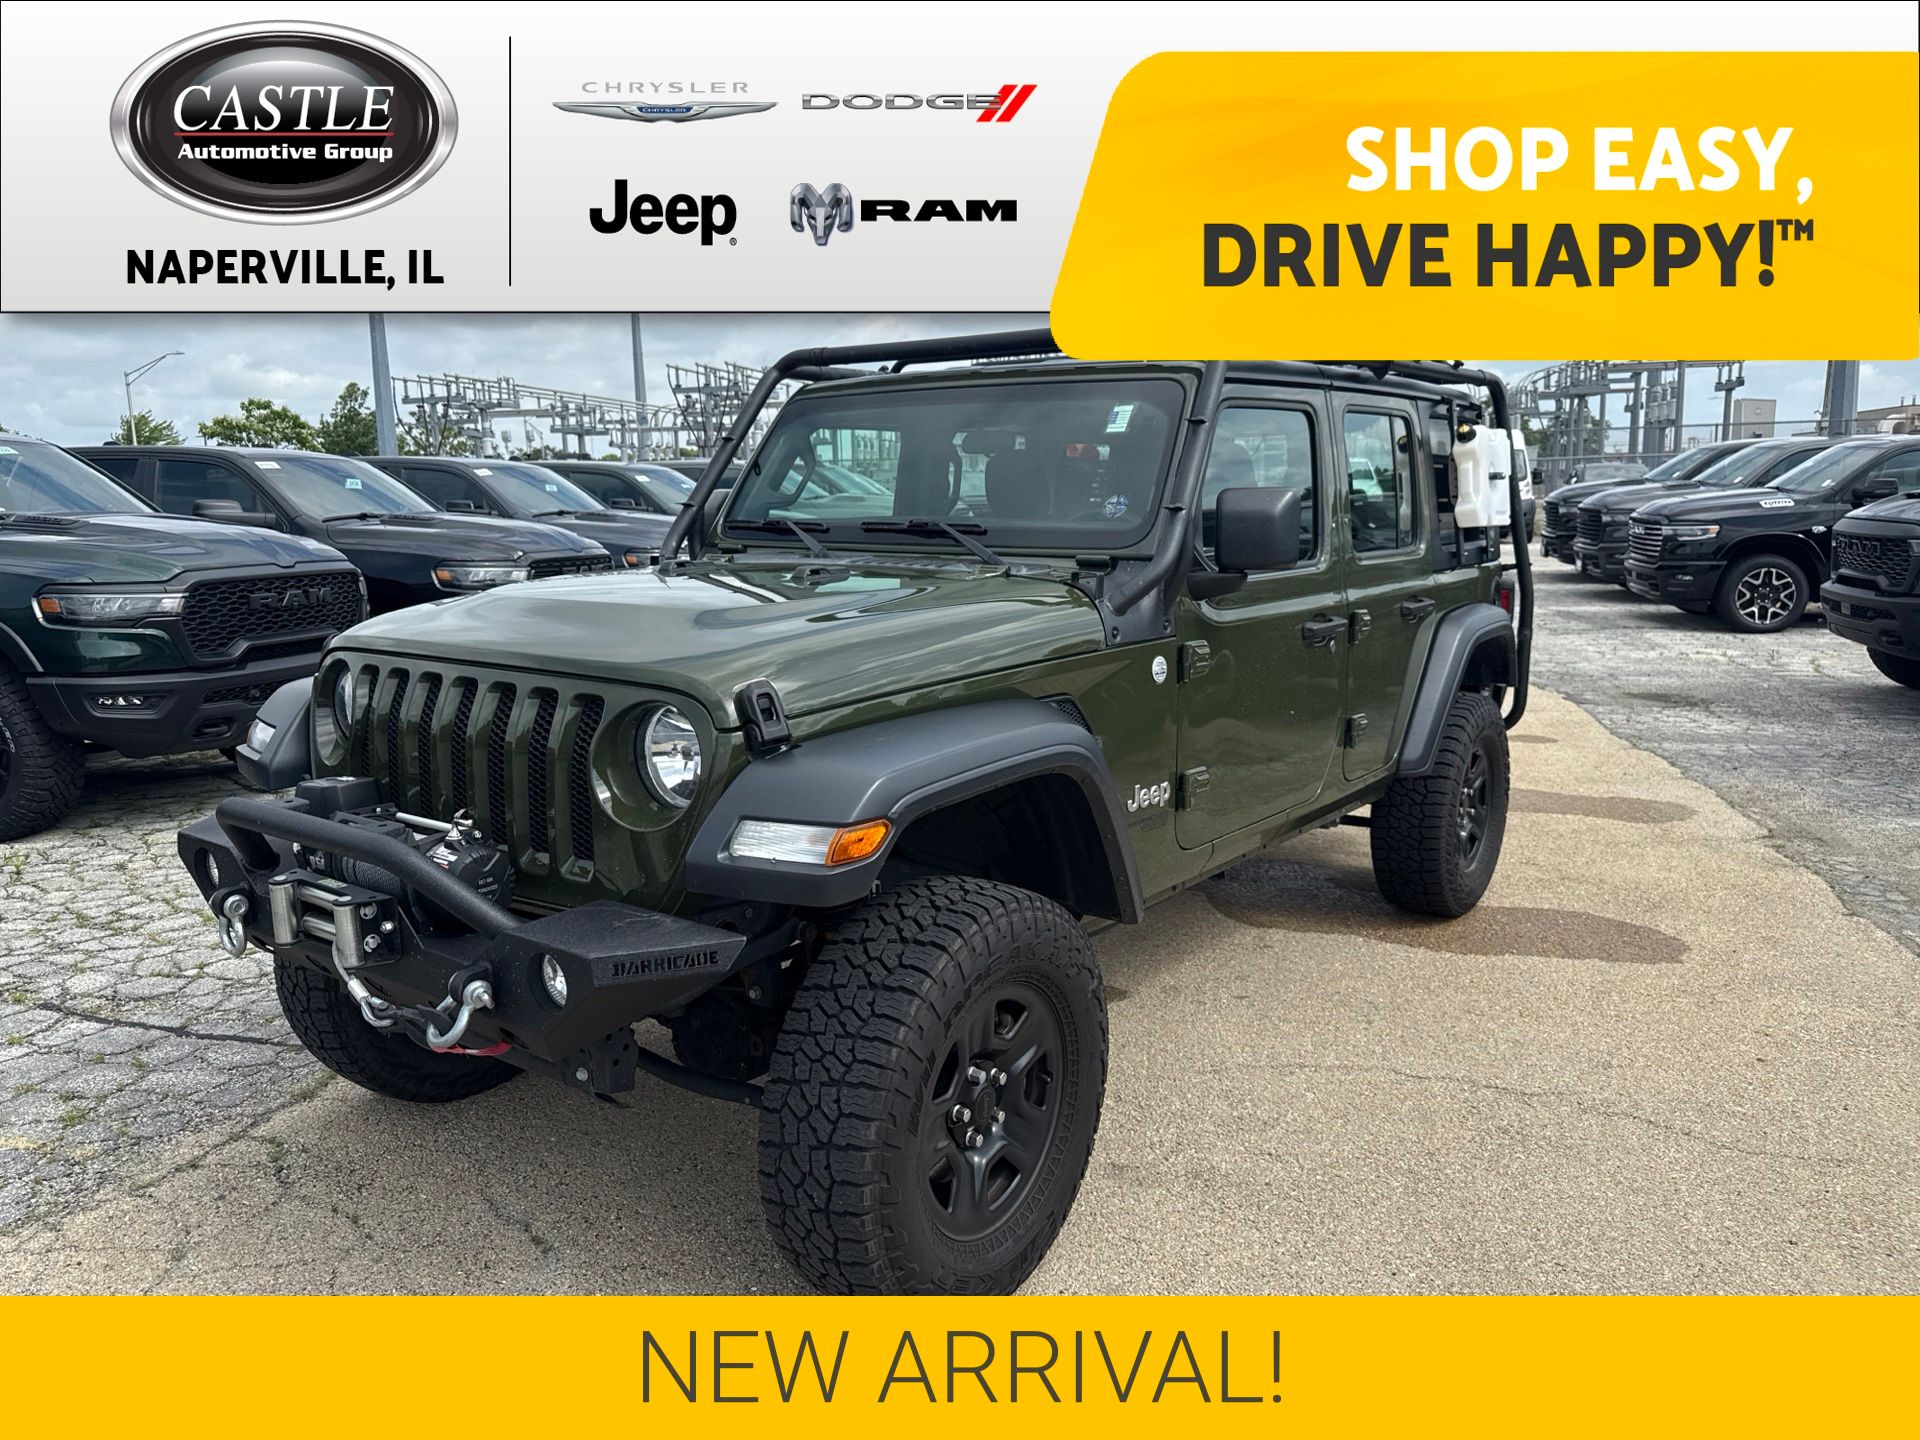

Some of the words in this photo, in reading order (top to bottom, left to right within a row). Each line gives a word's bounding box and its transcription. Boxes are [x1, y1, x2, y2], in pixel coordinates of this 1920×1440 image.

[249, 587, 332, 610] RAM
[1126, 780, 1171, 813] Jeep
[611, 950, 720, 977] BARRICADE
